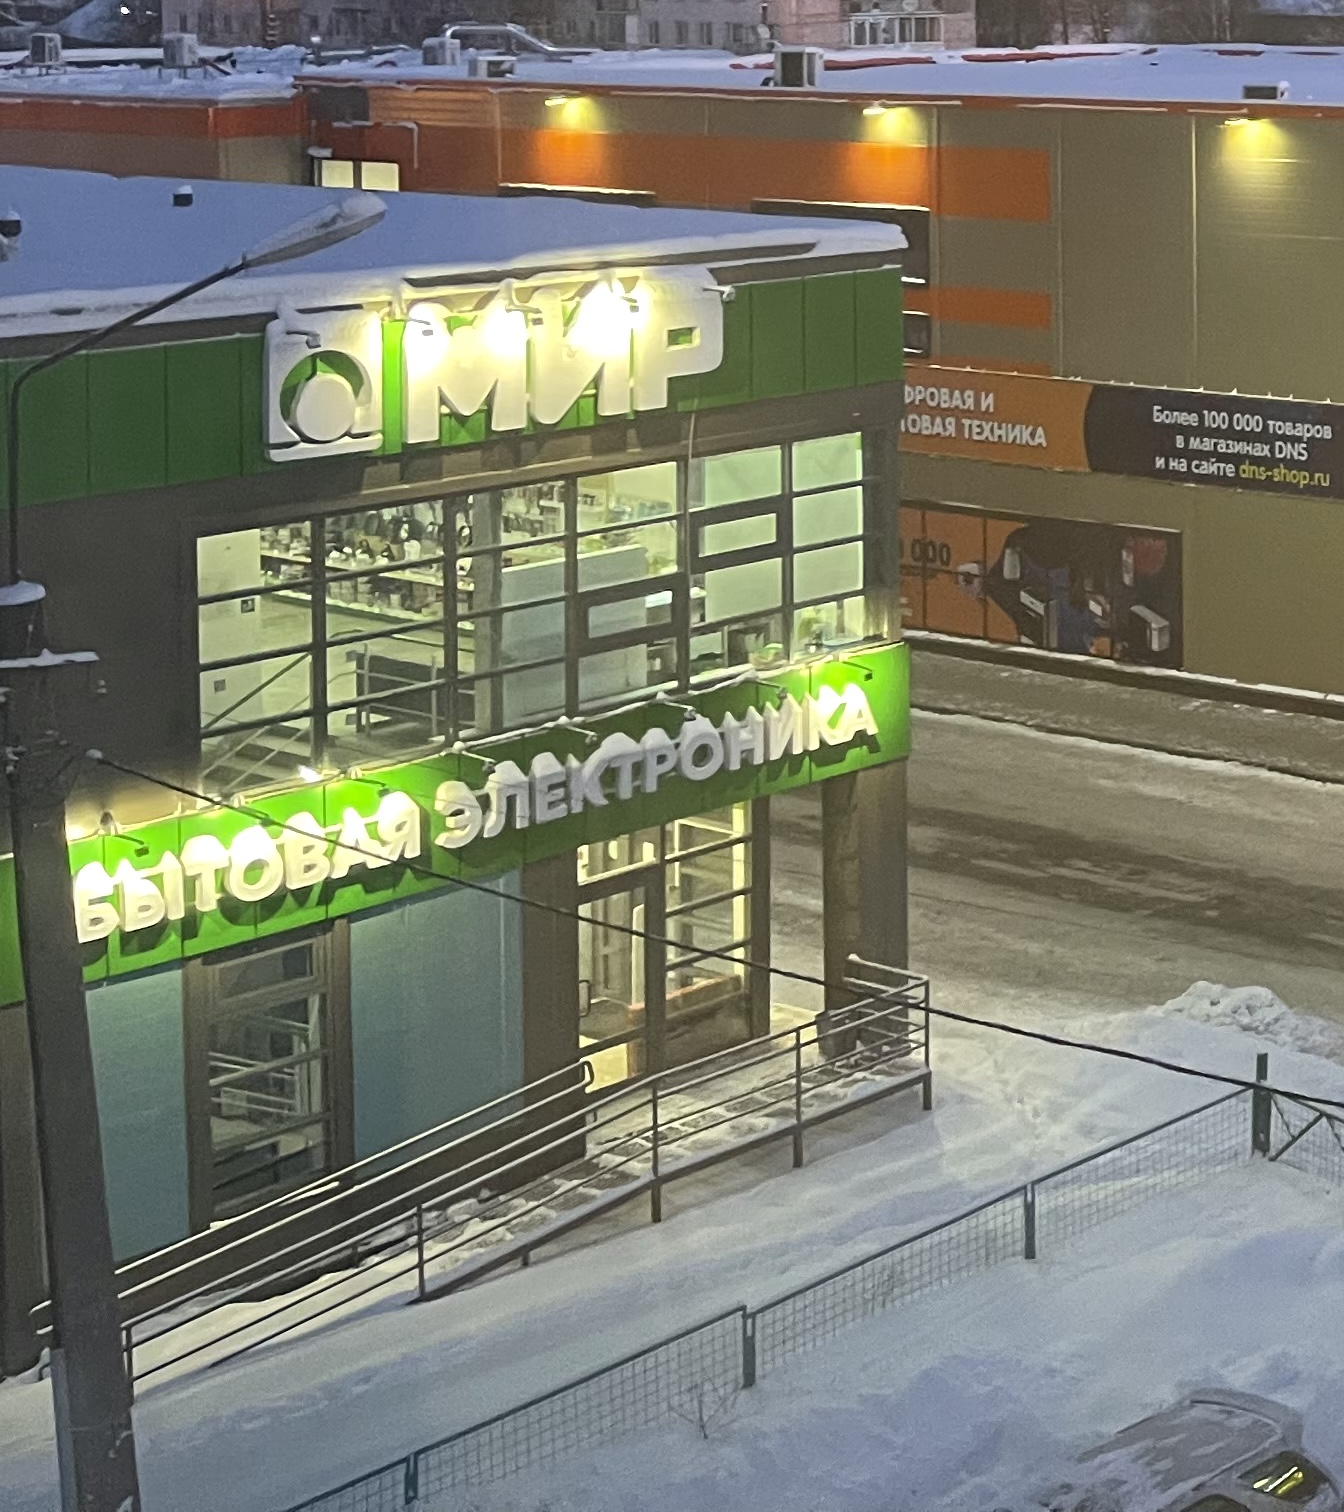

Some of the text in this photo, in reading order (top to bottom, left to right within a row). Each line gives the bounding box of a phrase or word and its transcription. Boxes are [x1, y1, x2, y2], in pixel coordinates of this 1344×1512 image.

[403, 268, 724, 444] МИР
[981, 391, 994, 413] И
[961, 418, 1048, 448] ТЕХНИКА
[1153, 405, 1333, 442] Более 100 000 товаров
[1176, 435, 1309, 461] в магазинах DNS
[1155, 456, 1331, 488] и на сайте dns-shop.ru
[75, 686, 879, 944] БЫТОВАЯ ЭЛЕКТРОНИКА
